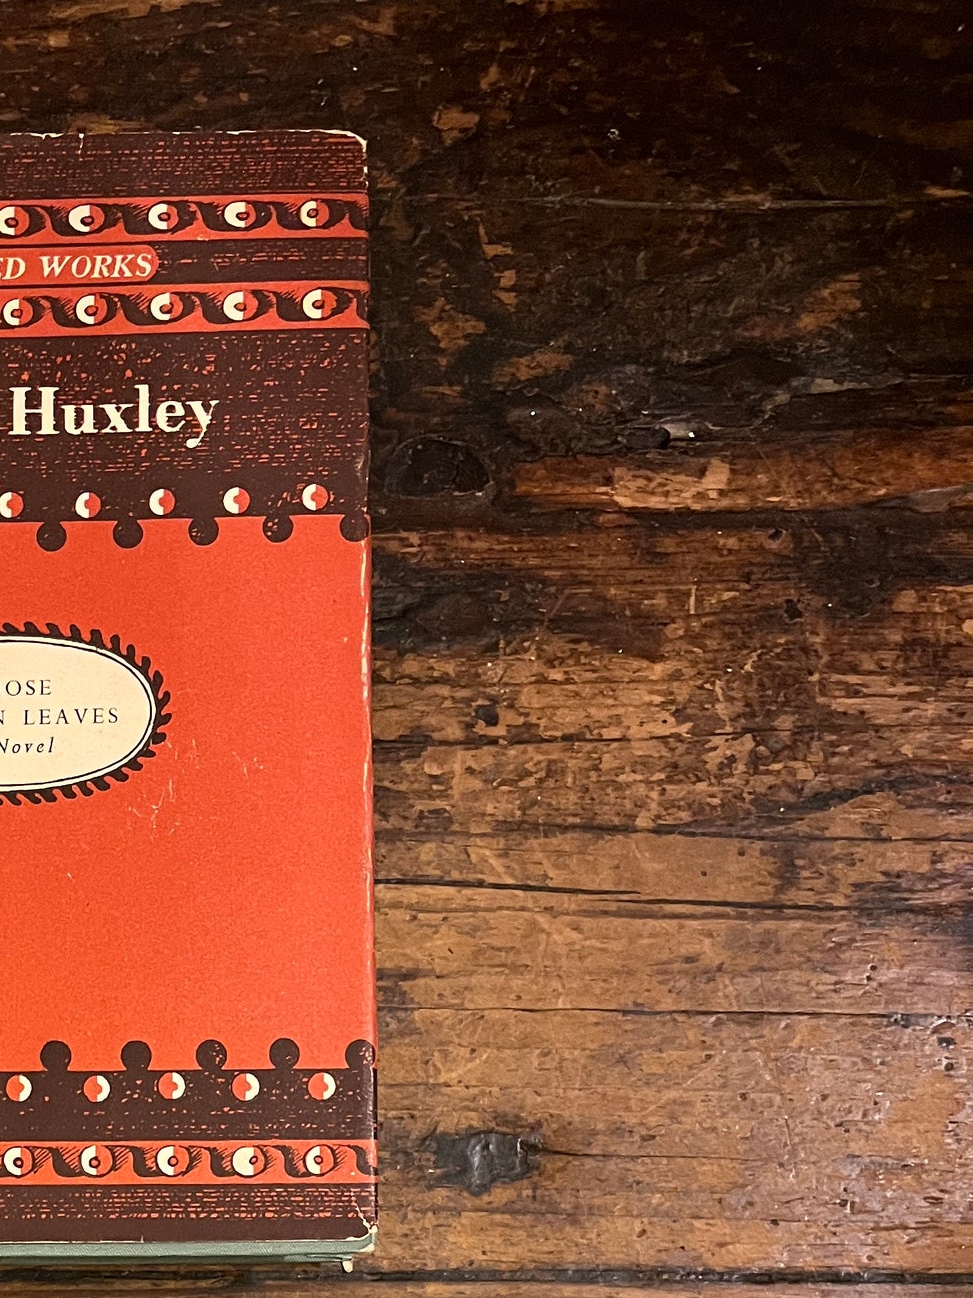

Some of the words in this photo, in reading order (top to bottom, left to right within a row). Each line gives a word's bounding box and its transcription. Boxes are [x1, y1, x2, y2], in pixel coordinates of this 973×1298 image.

[39, 253, 152, 278] WORKS
[7, 383, 220, 449] Huxley
[23, 707, 119, 726] LEAVES
